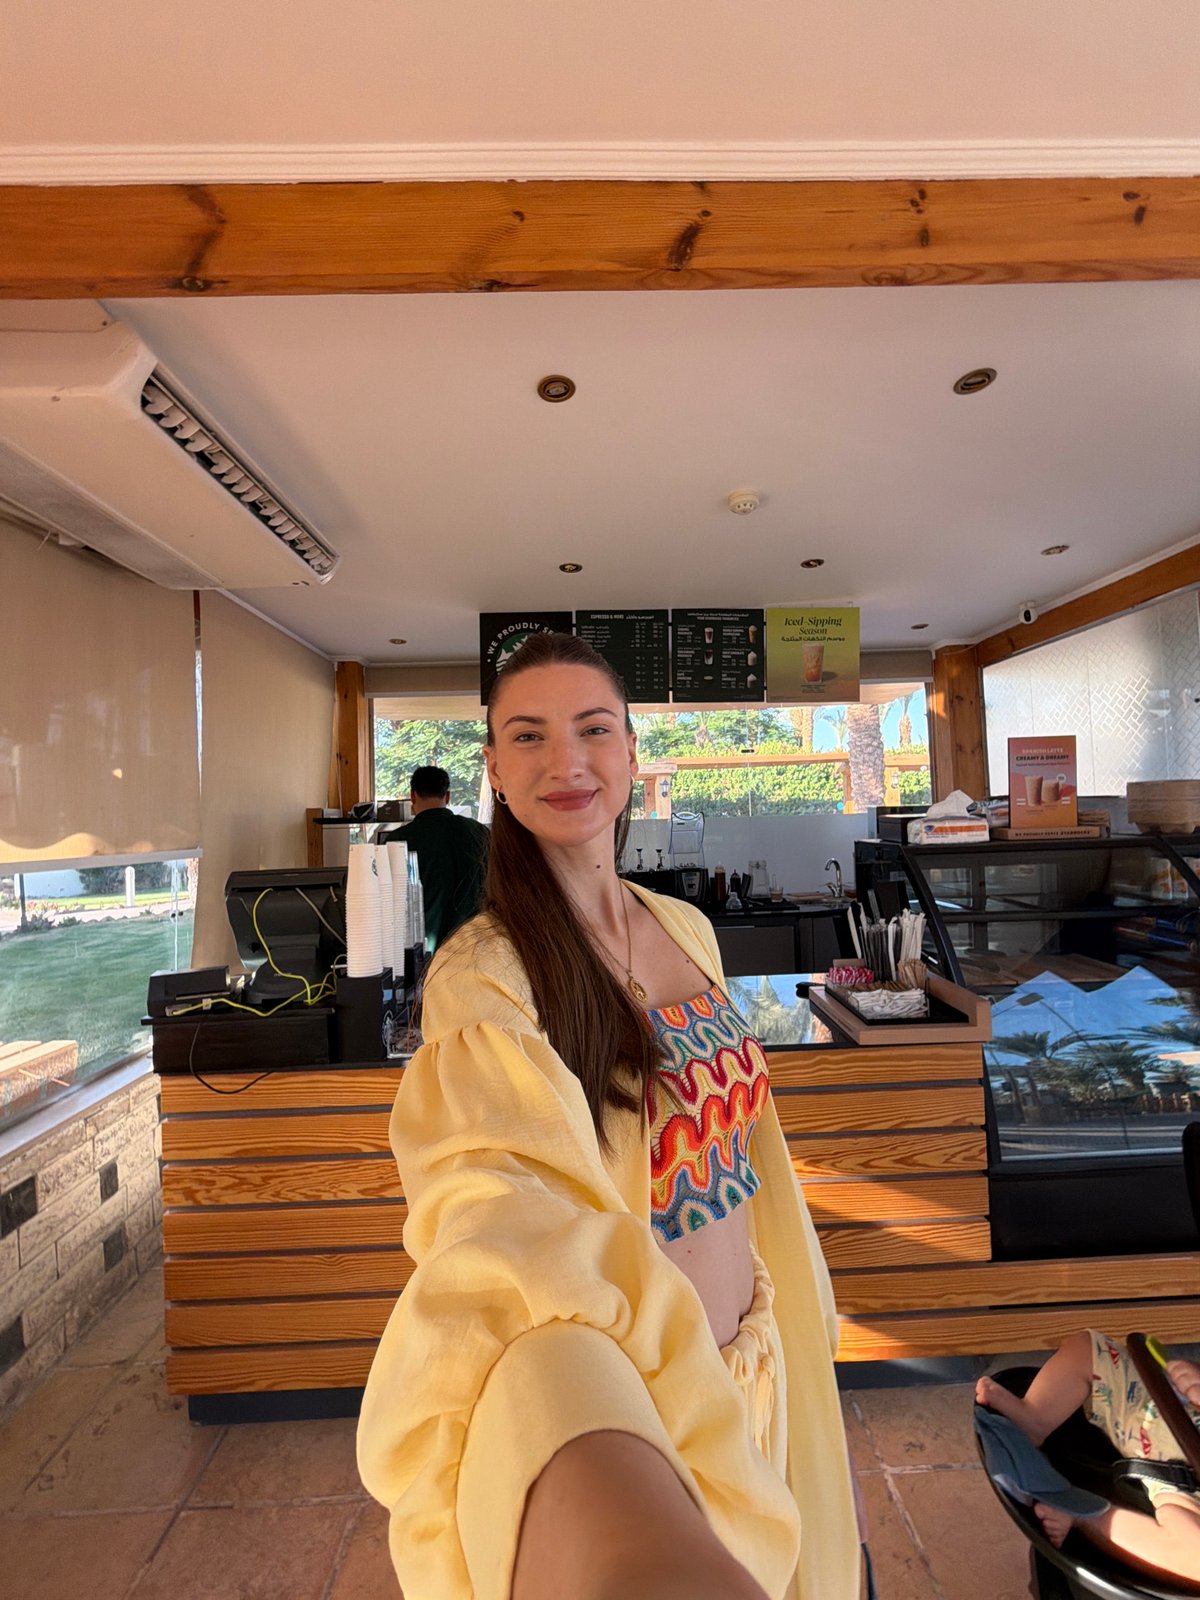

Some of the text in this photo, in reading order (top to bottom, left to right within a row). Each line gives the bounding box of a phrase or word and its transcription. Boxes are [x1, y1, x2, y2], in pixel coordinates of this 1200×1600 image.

[784, 616, 842, 627] Iced Sipping
[487, 640, 498, 654] WE
[497, 622, 540, 640] PROUDLY
